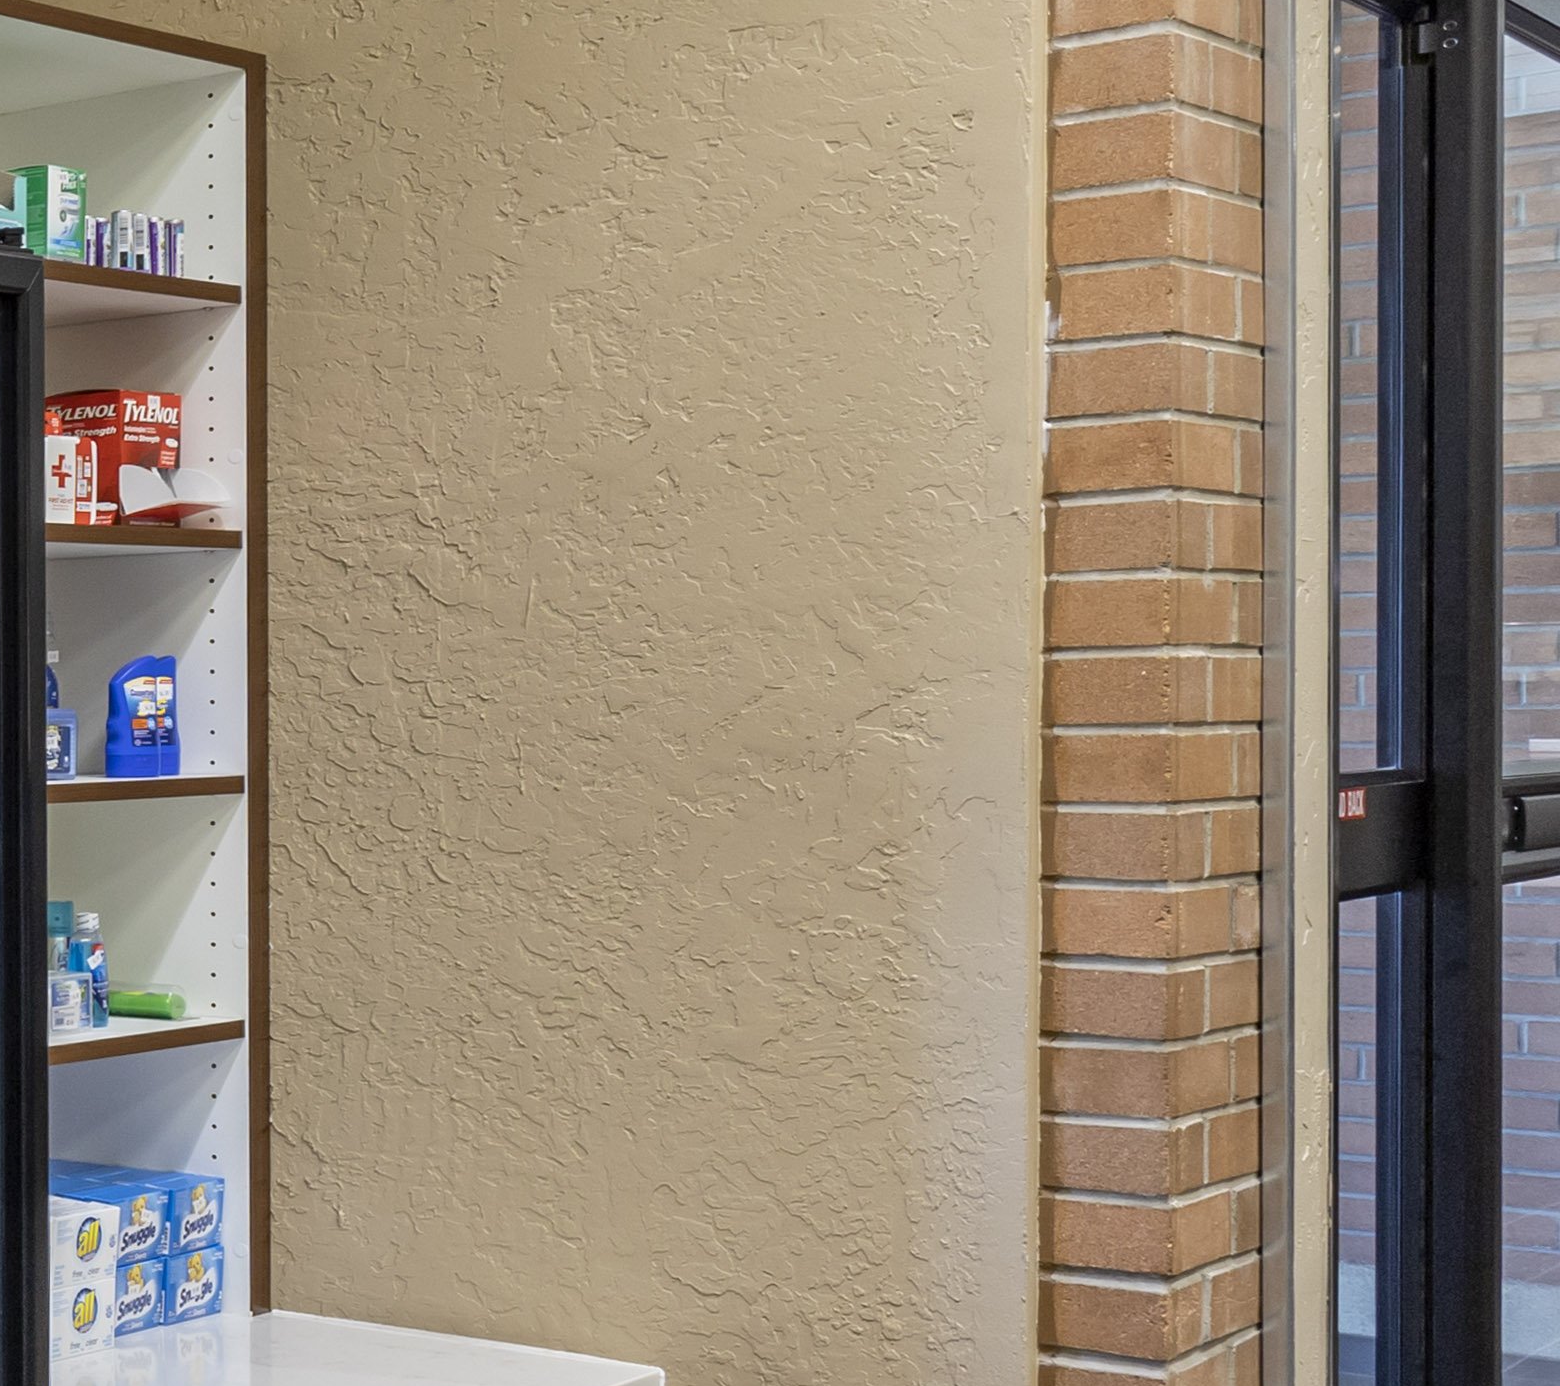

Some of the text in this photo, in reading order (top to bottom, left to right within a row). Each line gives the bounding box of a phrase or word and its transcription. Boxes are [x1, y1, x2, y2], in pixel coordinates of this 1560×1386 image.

[123, 398, 179, 424] TYLENOL
[74, 426, 116, 437] Strength
[122, 1220, 157, 1252] Snuggle
[183, 1208, 215, 1239] Snuggle
[76, 1220, 99, 1262] all
[73, 1290, 96, 1329] all
[118, 1286, 153, 1320] Snuggle
